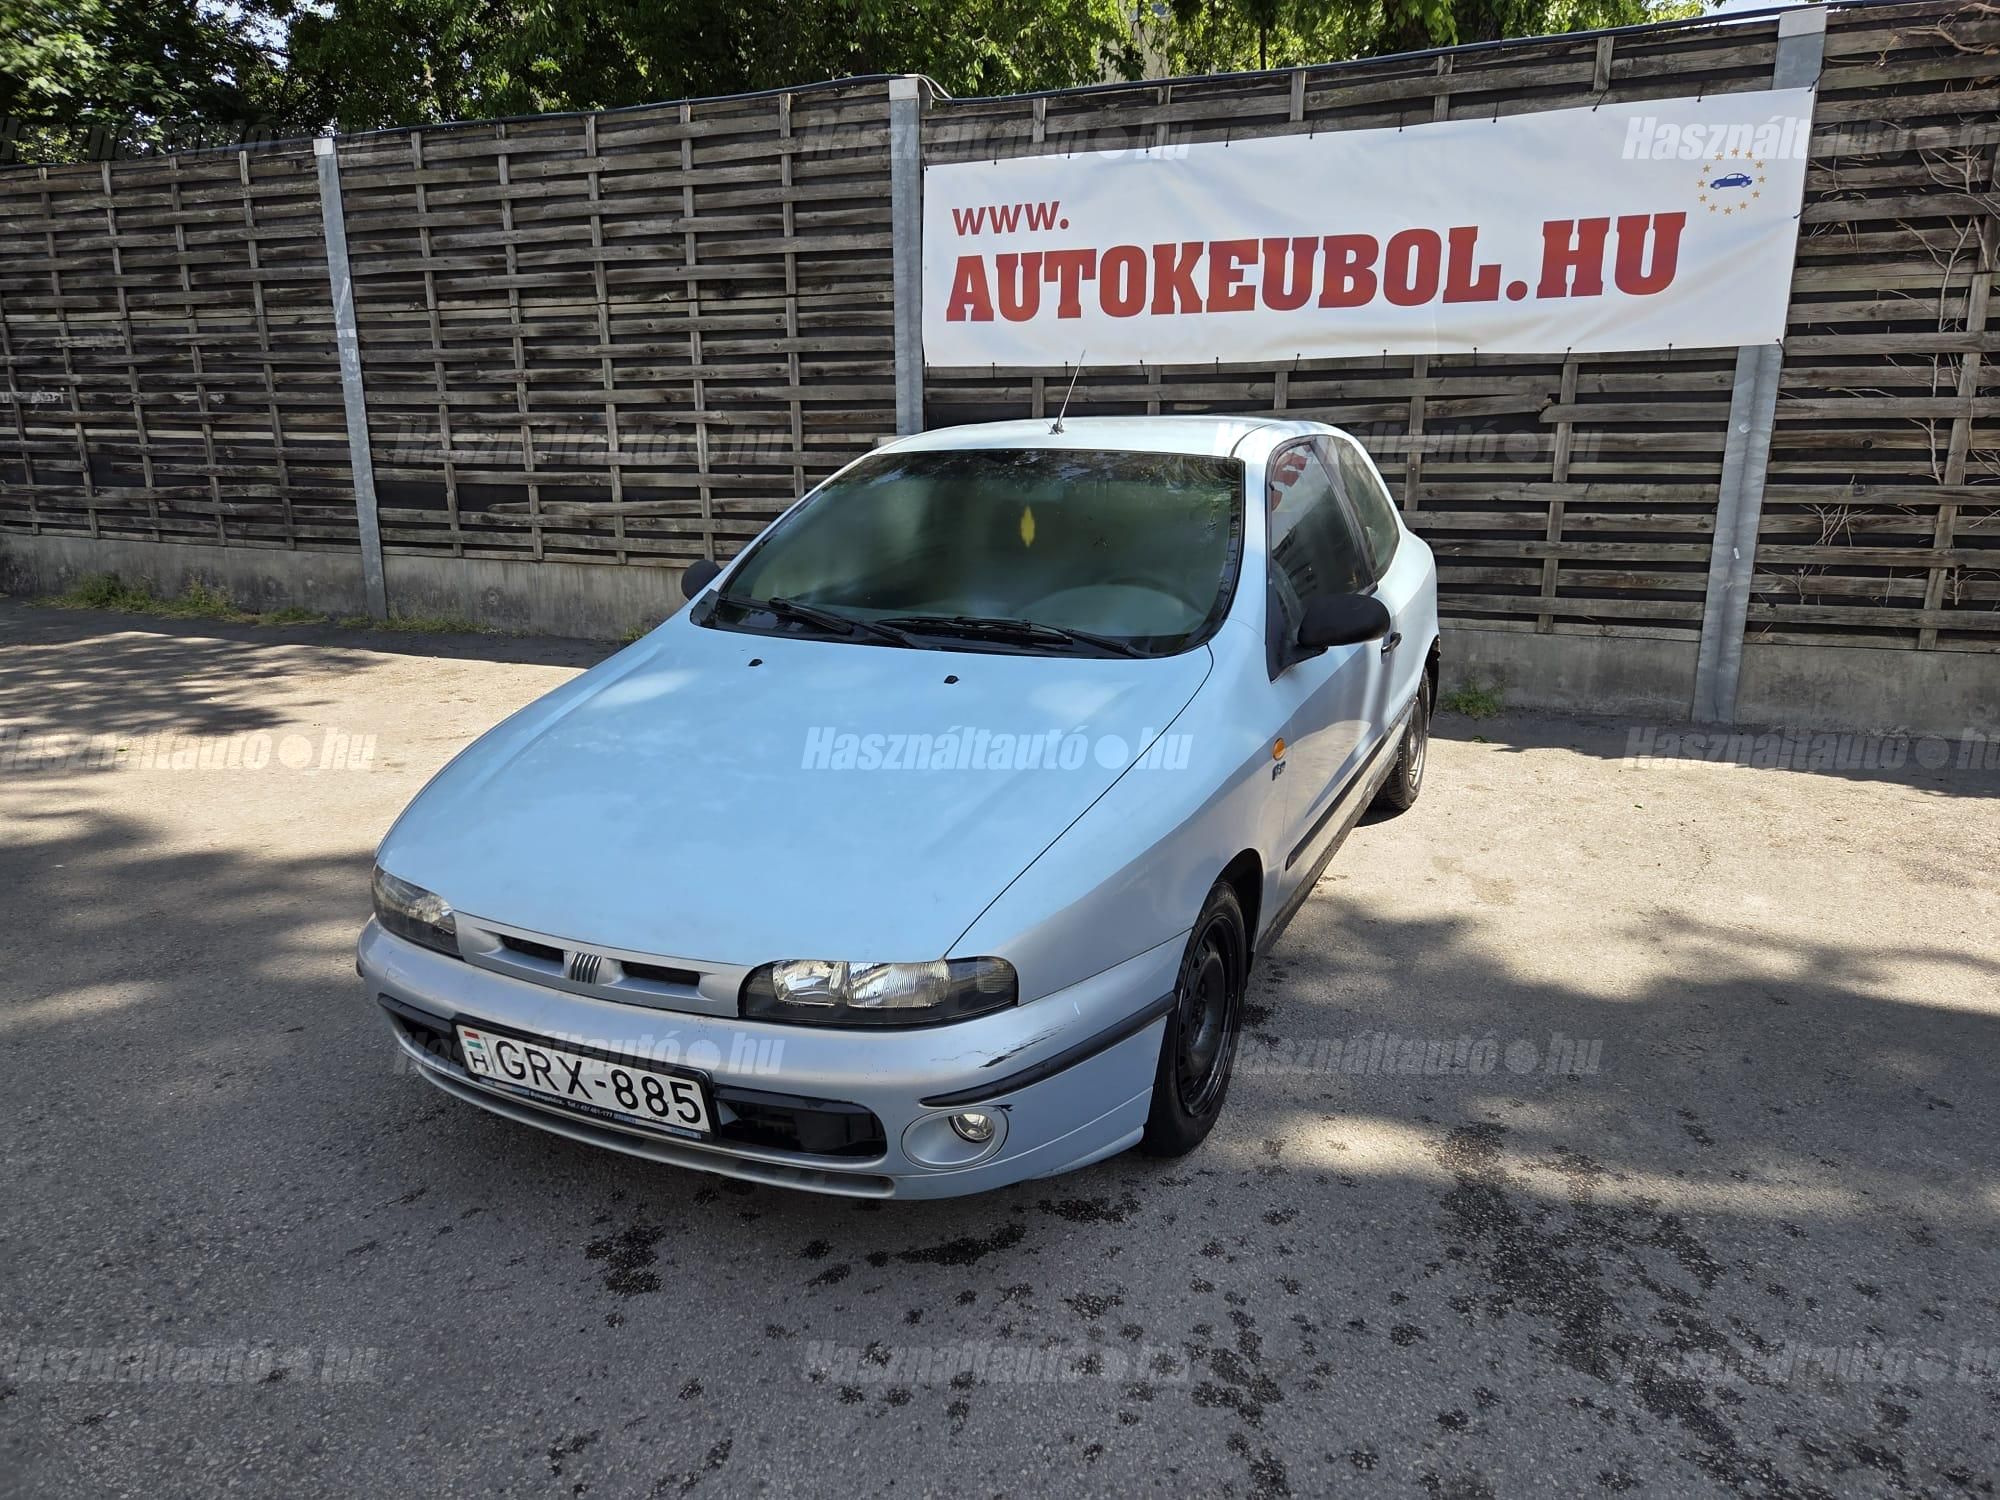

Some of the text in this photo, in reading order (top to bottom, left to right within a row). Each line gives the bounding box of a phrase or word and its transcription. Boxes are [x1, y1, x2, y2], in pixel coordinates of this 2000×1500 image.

[950, 199, 1071, 237] www.
[945, 211, 1688, 323] AUTOKEUBOL.HU
[469, 1040, 701, 1125] H GRX-885
